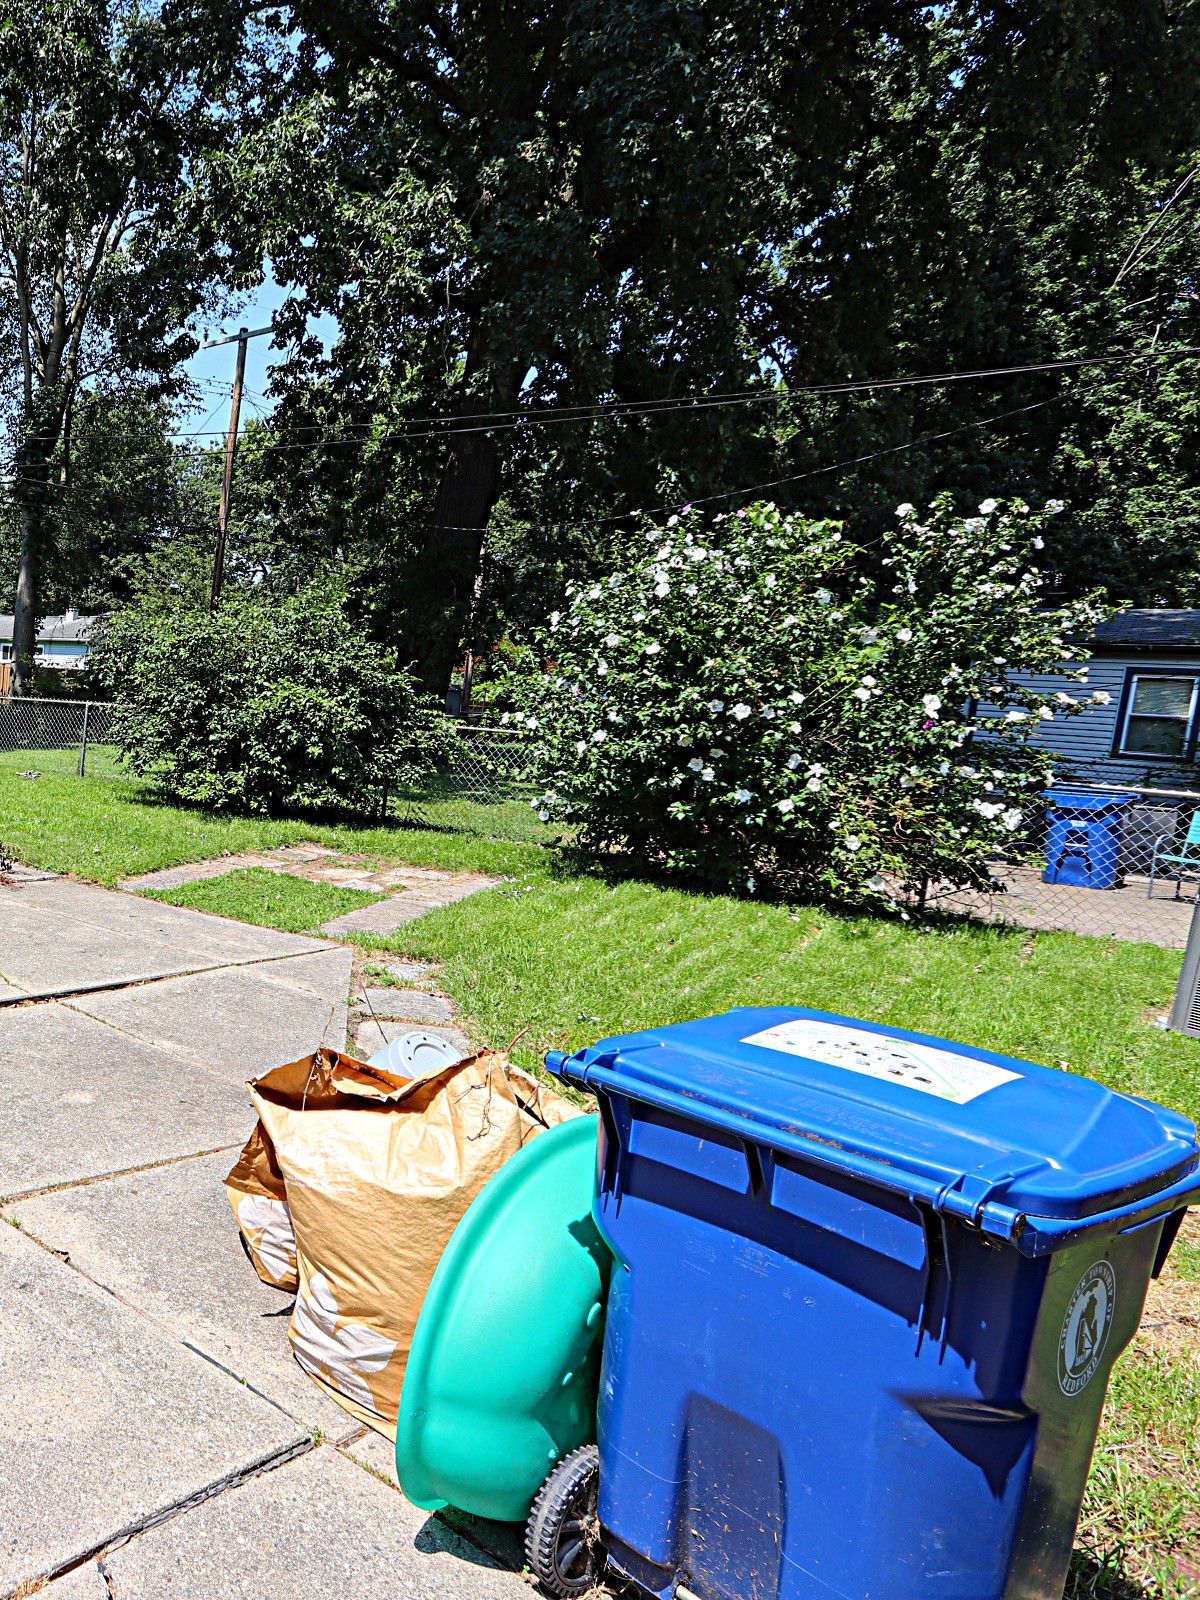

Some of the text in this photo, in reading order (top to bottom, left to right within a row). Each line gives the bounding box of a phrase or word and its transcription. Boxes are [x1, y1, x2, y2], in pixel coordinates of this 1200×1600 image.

[1060, 1278, 1086, 1350] CHARTER
[1105, 1303, 1113, 1322] OF
[1062, 1356, 1098, 1392] REDFORD
